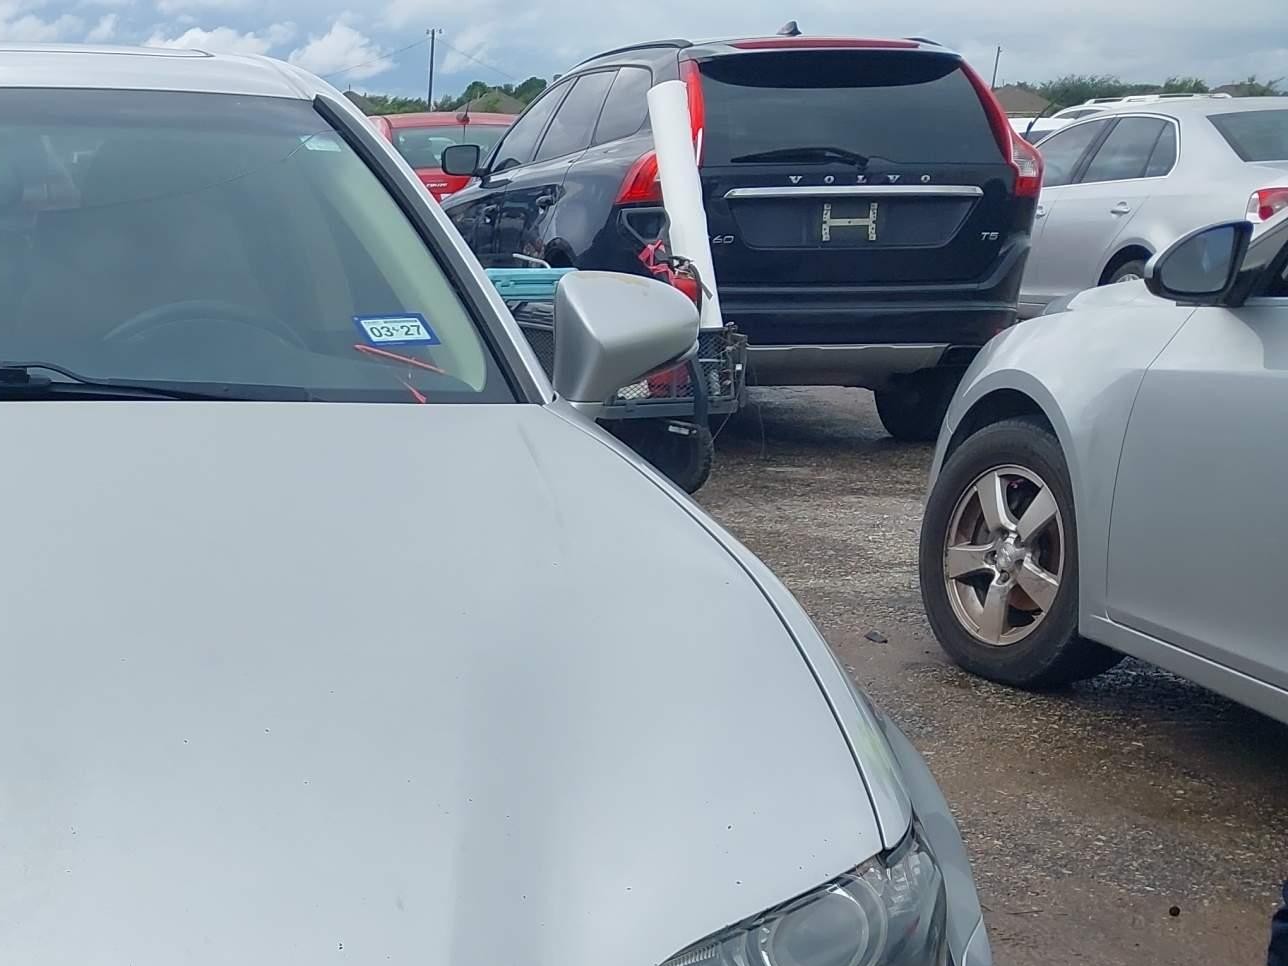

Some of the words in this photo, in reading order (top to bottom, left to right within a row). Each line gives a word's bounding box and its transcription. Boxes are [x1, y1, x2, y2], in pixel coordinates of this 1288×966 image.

[788, 173, 931, 185] VOLVO
[710, 234, 735, 244] 60
[980, 231, 999, 241] T5
[369, 326, 394, 338] 03
[400, 324, 422, 336] 27
